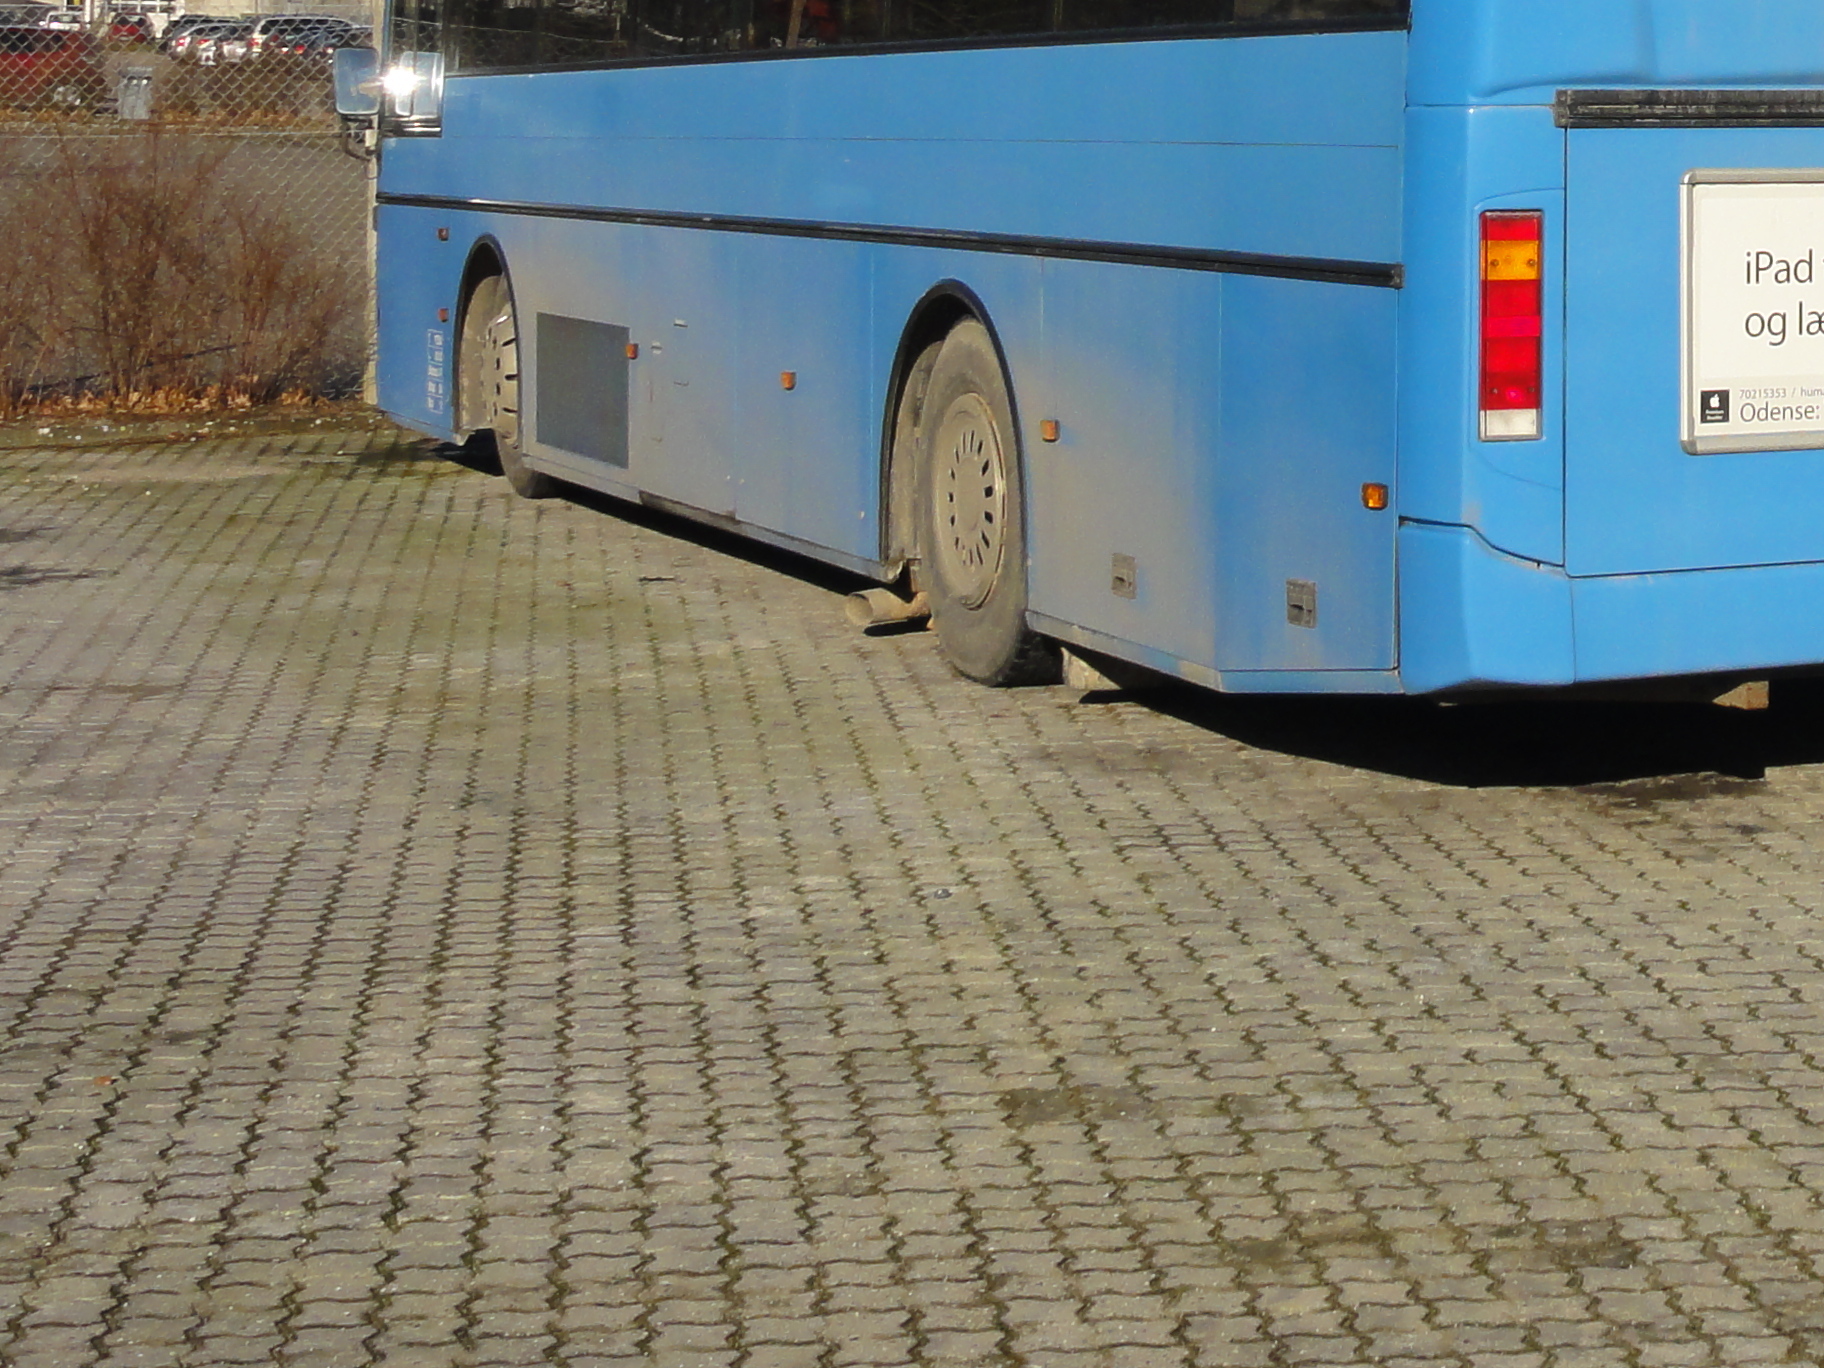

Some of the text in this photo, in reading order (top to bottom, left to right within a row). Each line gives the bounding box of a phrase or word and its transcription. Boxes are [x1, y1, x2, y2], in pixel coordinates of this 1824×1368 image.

[1745, 249, 1813, 286] iPad
[1744, 311, 1788, 346] og
[1740, 401, 1820, 422] Odense:
